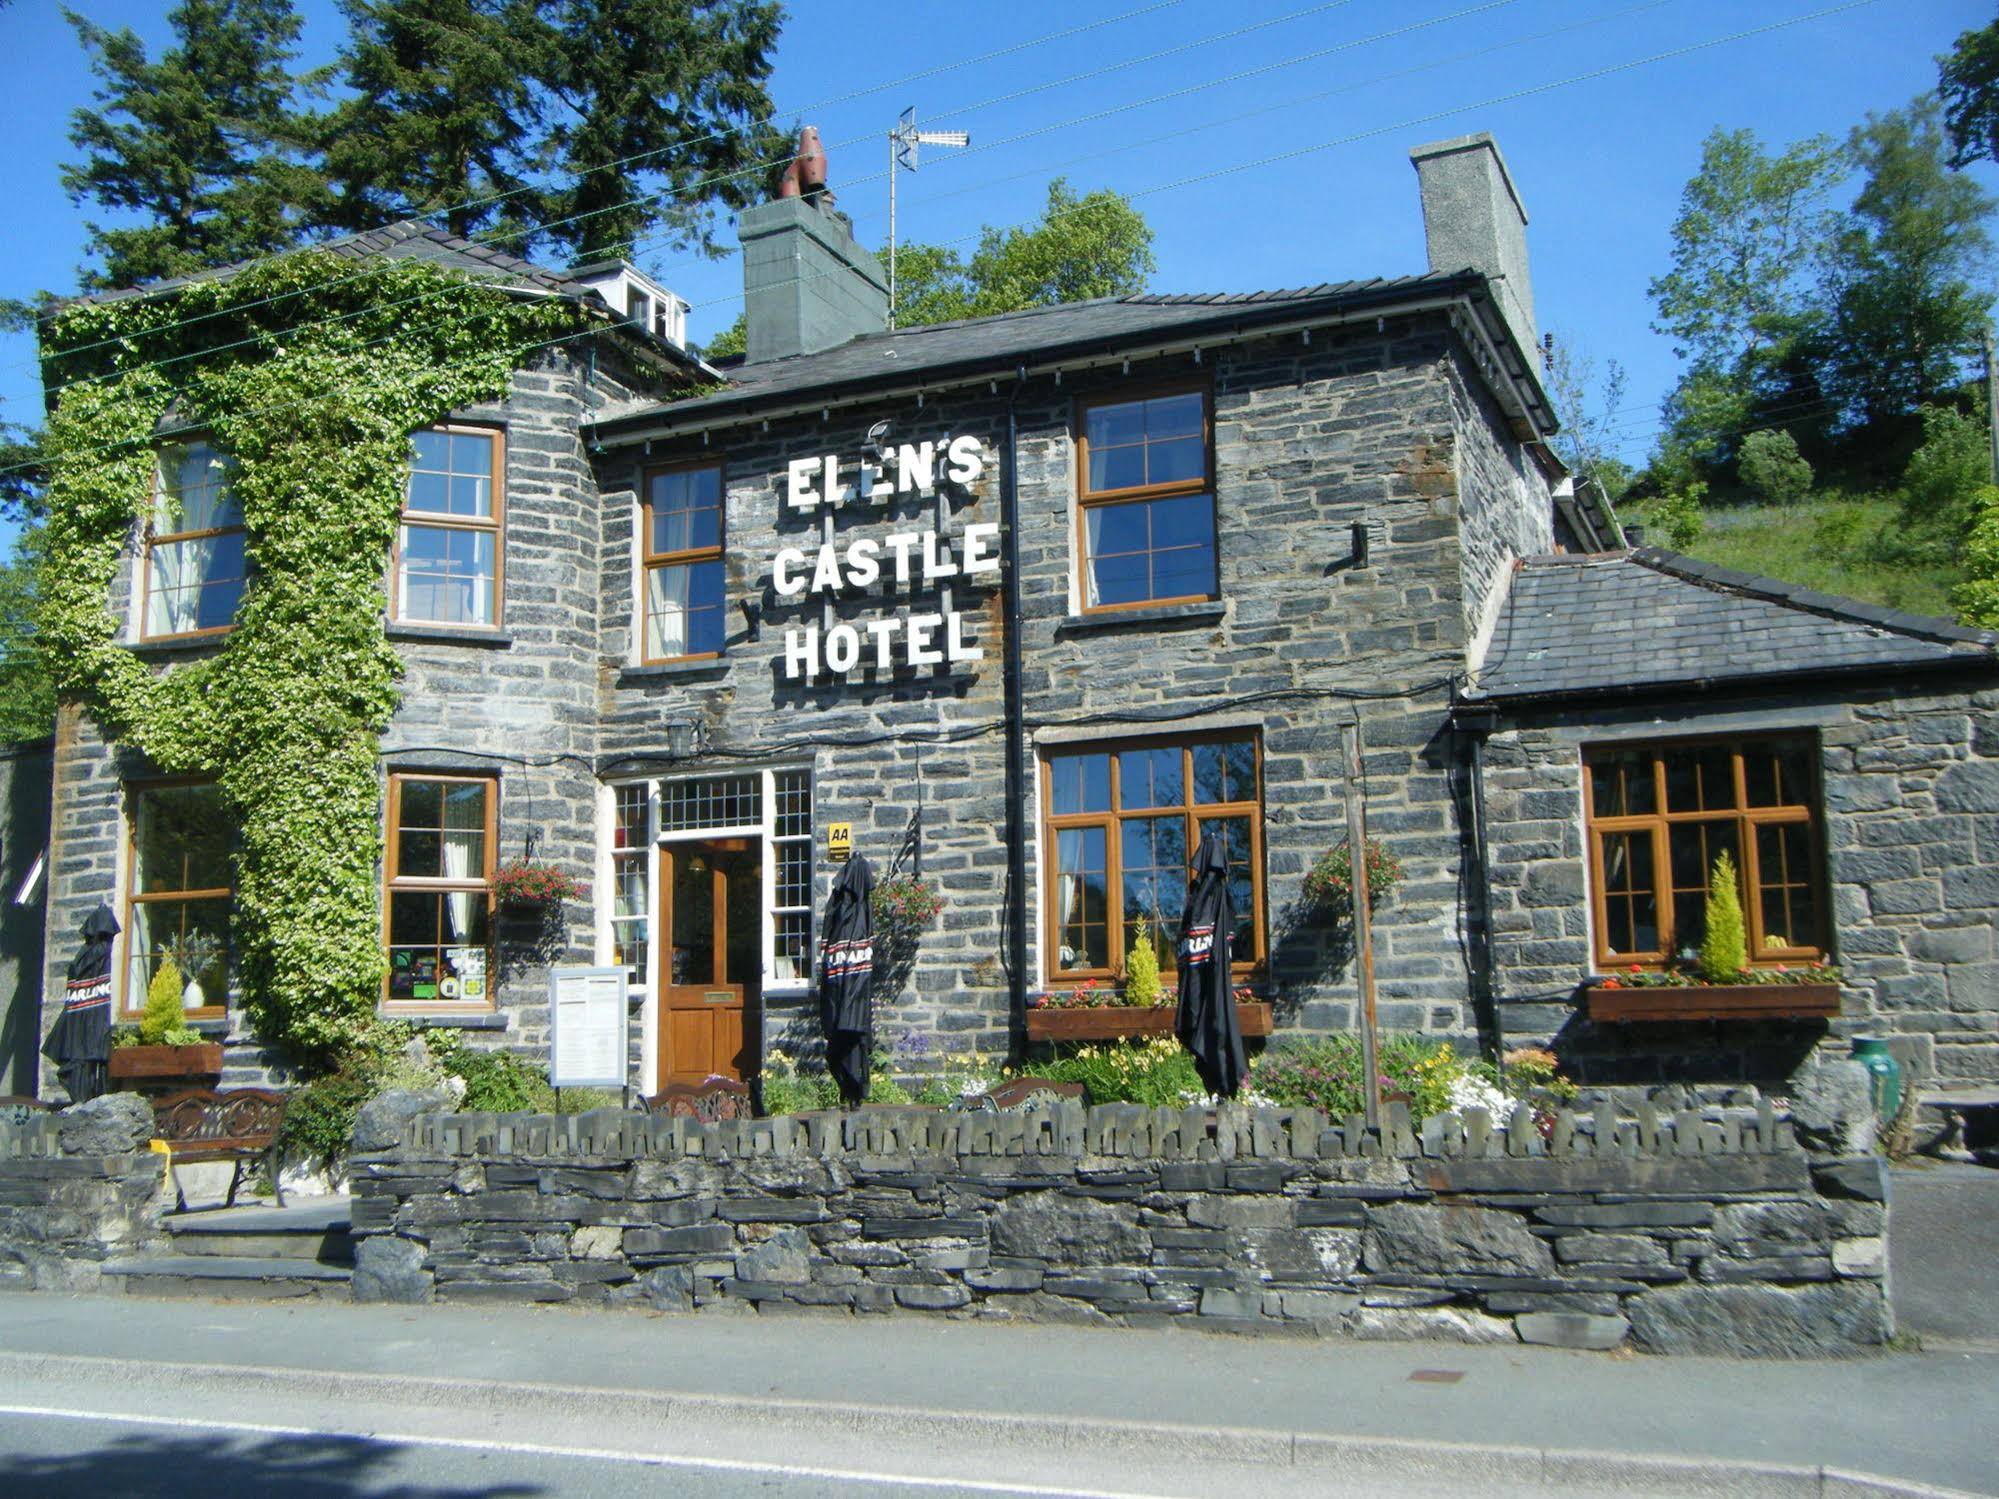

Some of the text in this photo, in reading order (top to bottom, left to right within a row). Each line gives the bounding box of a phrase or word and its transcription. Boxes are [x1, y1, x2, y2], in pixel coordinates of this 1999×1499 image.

[773, 522, 999, 596] CASTLE
[785, 611, 985, 679] HOTEL
[831, 828, 849, 841] AA
